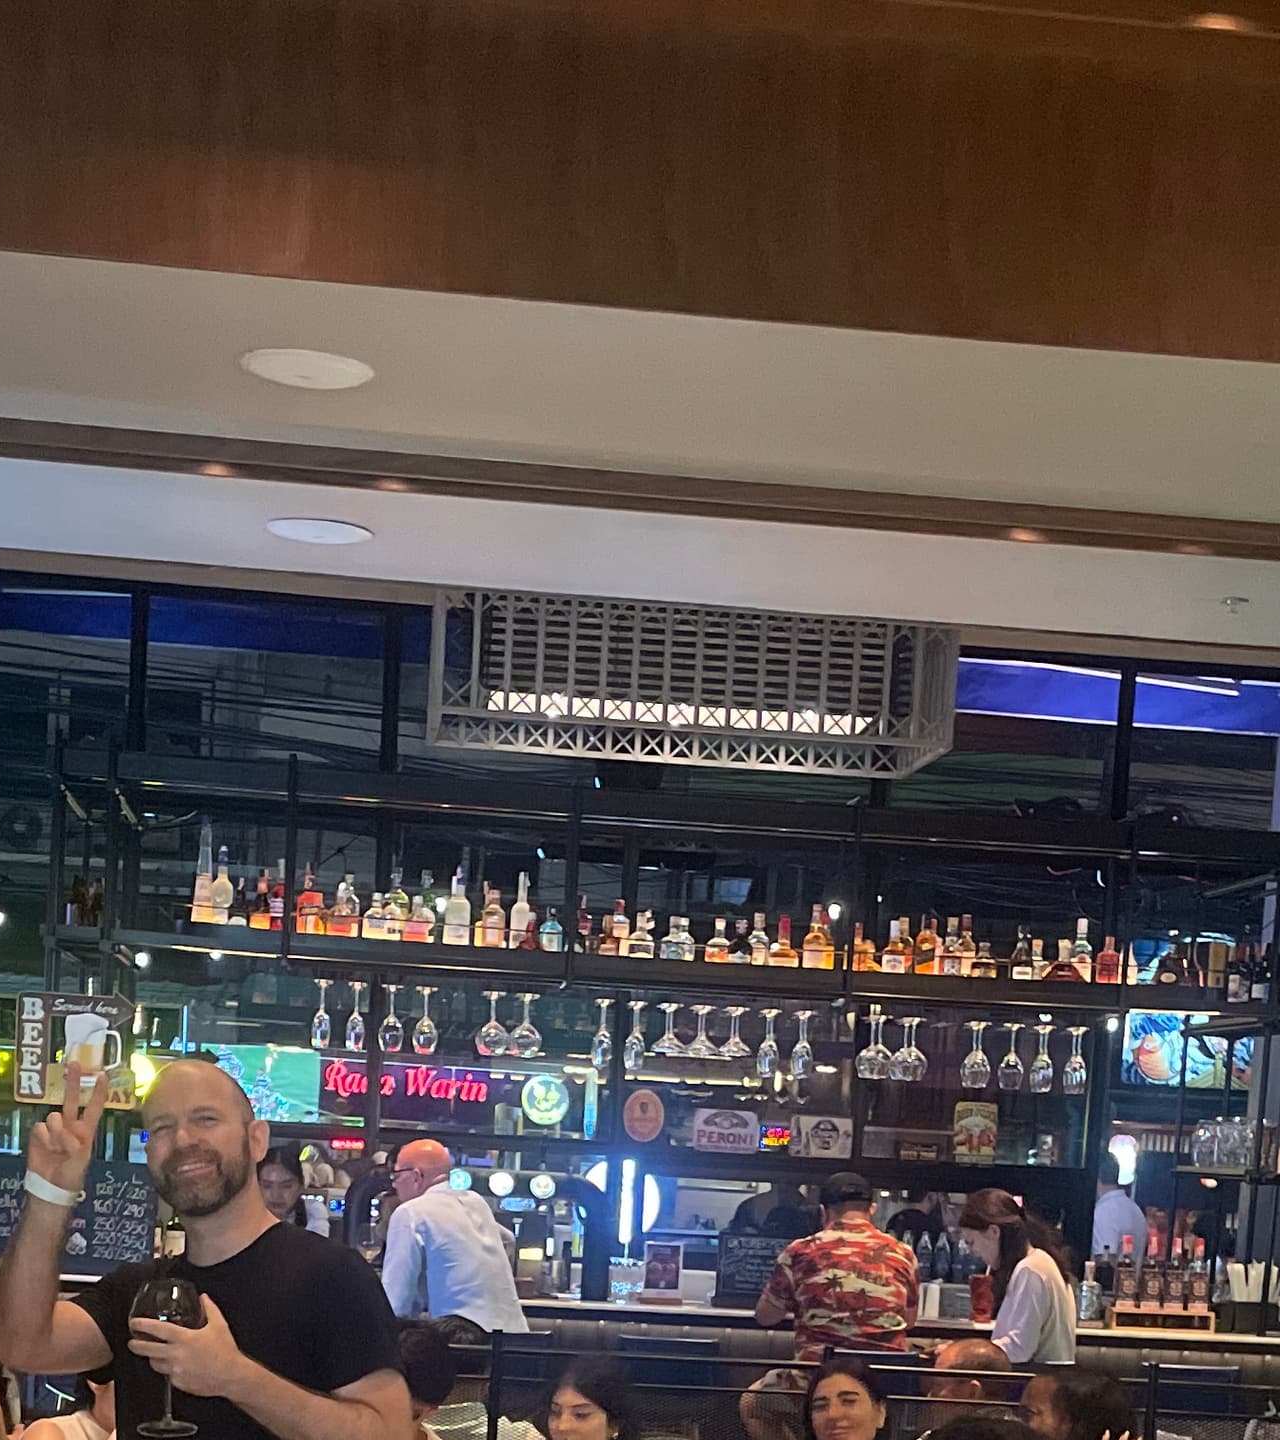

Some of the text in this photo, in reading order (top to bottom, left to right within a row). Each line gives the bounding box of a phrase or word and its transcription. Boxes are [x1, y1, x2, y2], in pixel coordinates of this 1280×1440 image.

[19, 997, 45, 1095] BEER
[405, 1064, 489, 1103] Warin
[696, 1129, 755, 1146] PERONI
[105, 1170, 144, 1185] S L
